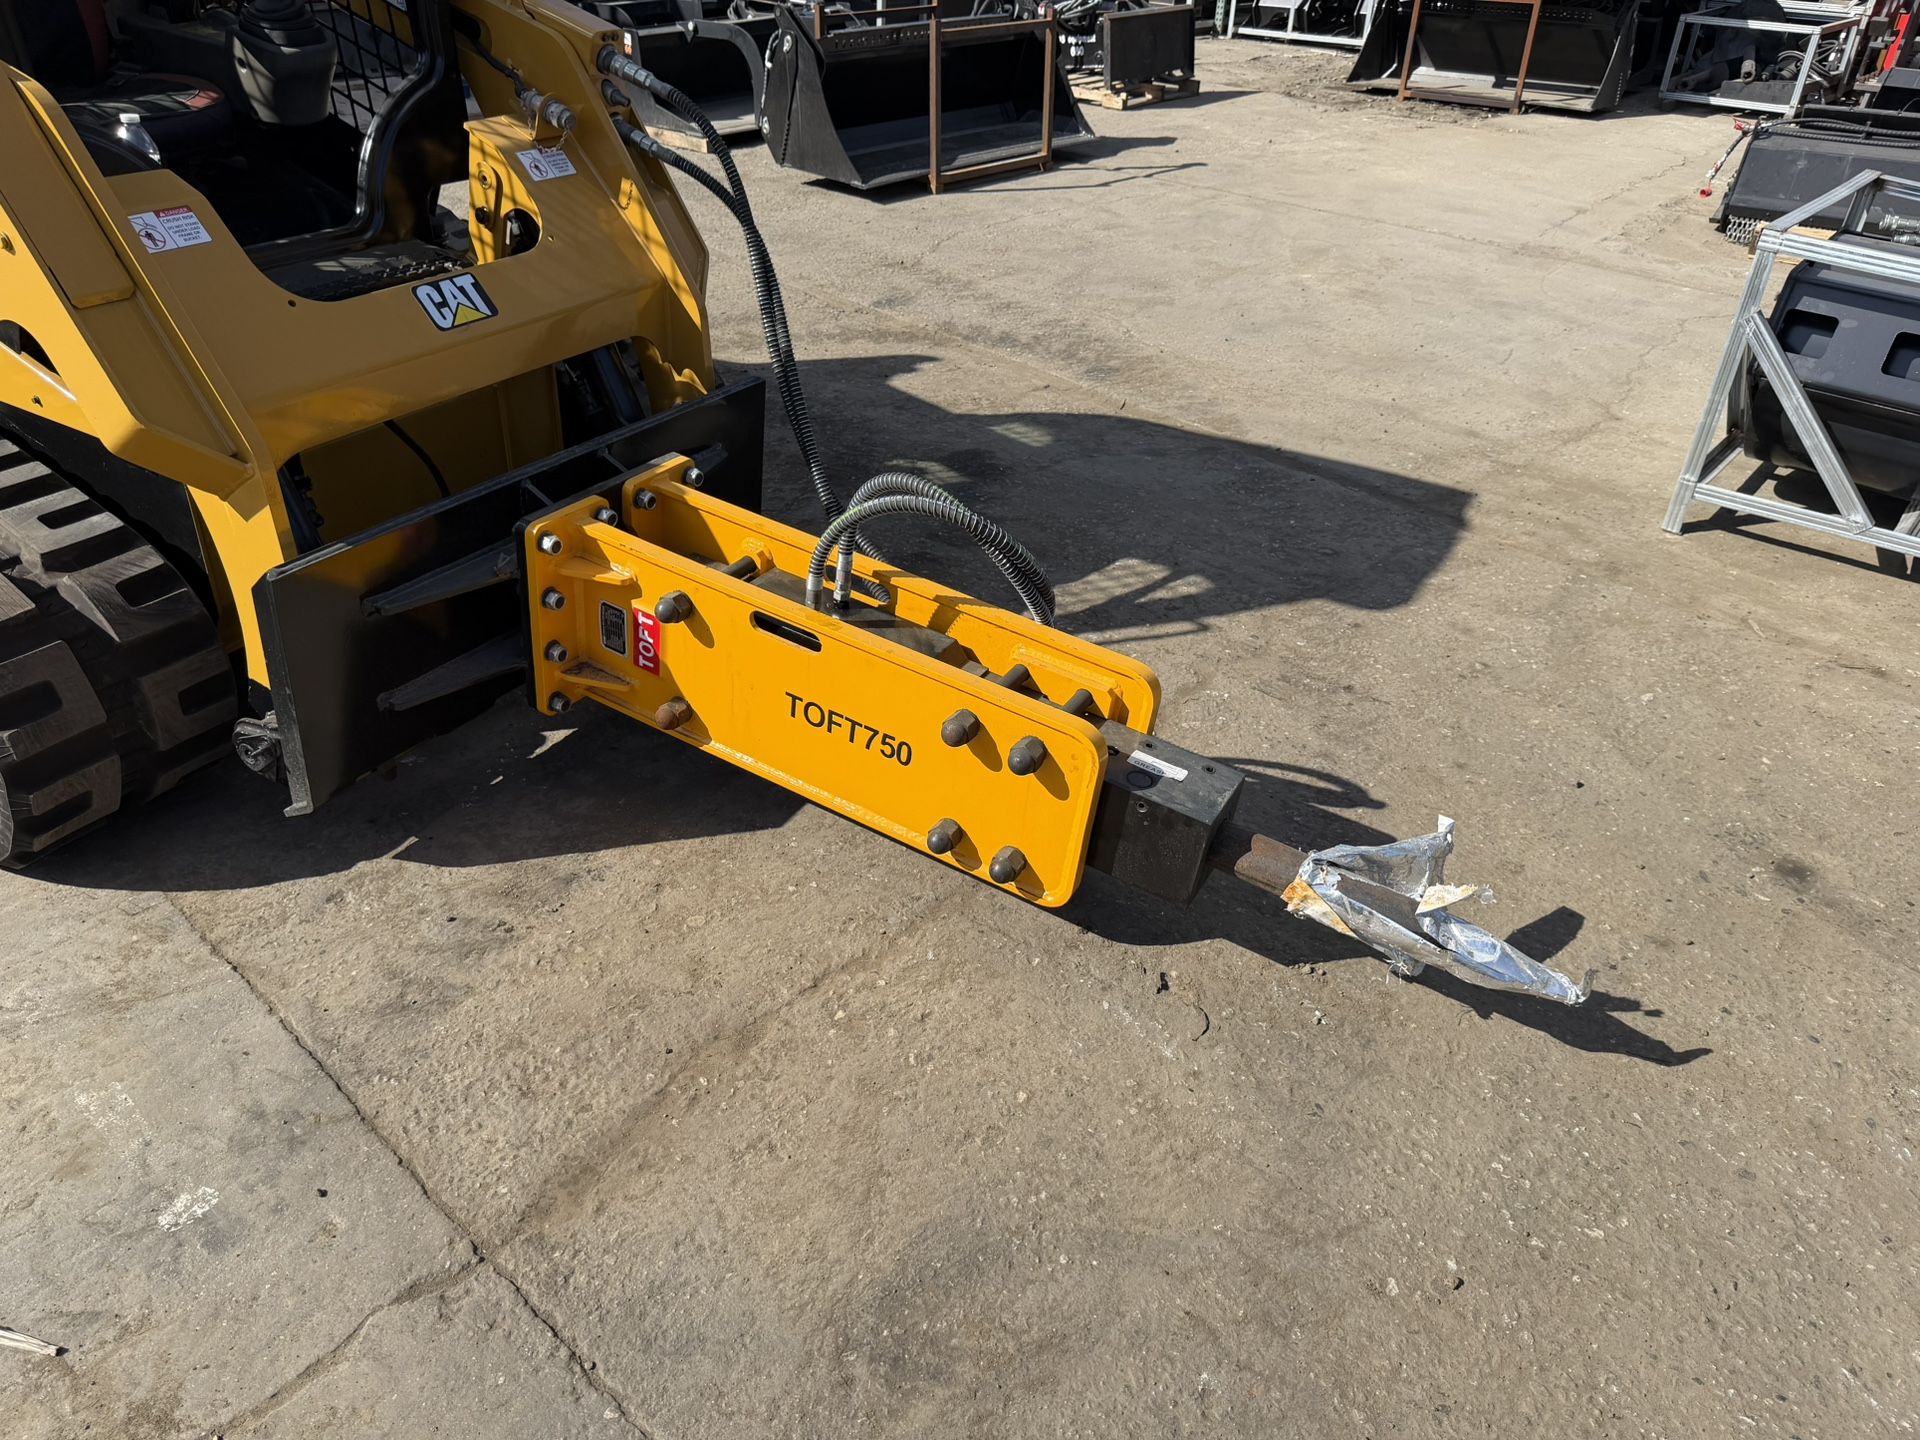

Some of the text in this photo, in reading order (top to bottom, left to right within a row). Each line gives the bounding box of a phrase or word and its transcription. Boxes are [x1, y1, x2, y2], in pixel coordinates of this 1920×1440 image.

[416, 274, 492, 328] CAT
[638, 611, 655, 668] TOFT
[785, 691, 912, 767] TOFT750
